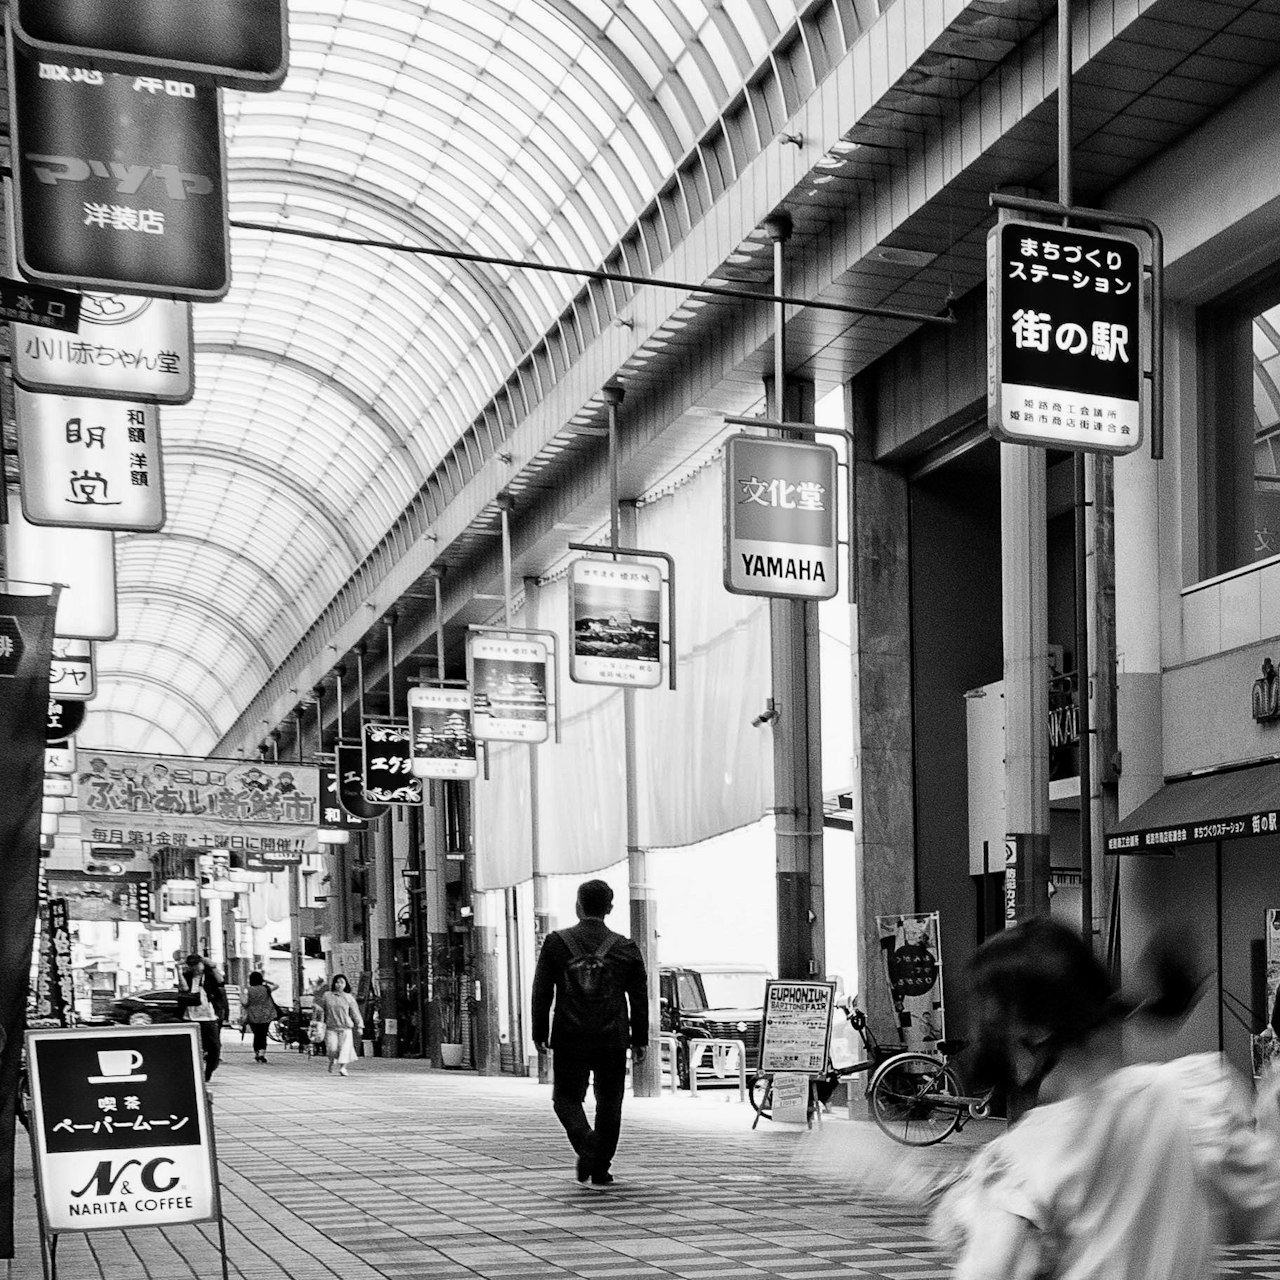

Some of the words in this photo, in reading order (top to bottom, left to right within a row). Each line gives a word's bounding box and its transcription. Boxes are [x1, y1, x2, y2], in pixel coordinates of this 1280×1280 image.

[83, 201, 165, 235] 洋装店
[1020, 238, 1122, 271] まちづくり
[1008, 260, 1132, 295] ステーション
[1011, 308, 1129, 363] 街の駅
[25, 336, 182, 375] 小川赤ちゃん堂
[737, 475, 826, 511] 文化堂
[741, 553, 826, 583] YAMAHA
[87, 780, 317, 824] ふれあい新鮮市
[1251, 812, 1277, 834] 街の駅
[770, 987, 829, 1001] EUPHONIUM
[805, 1003, 827, 1011] FAIR
[97, 1095, 142, 1112] 喫茶
[52, 1114, 190, 1134] ペーパームーン
[69, 1200, 128, 1216] NARITA
[135, 1196, 193, 1212] COFFEE
